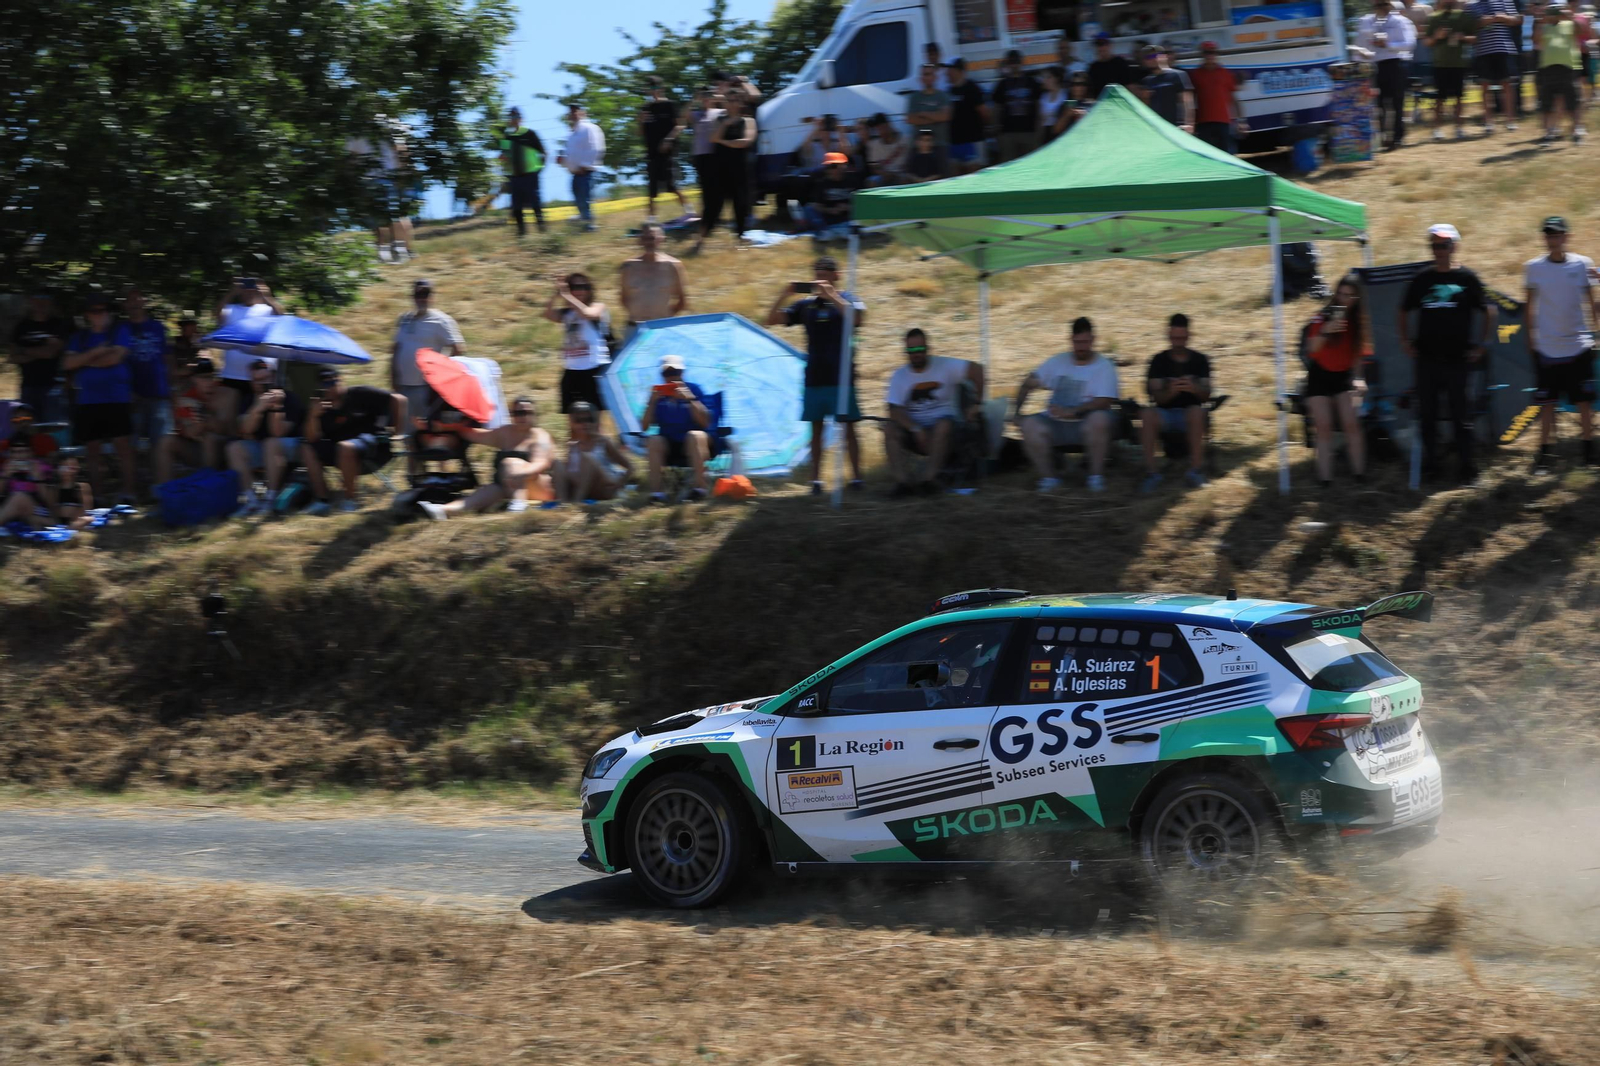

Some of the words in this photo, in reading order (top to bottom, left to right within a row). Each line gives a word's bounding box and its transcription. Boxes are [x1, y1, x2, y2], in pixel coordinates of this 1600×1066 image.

[1055, 660, 1082, 674] J.A.
[1086, 658, 1135, 672] Suárez
[1145, 655, 1160, 690] 1
[1224, 664, 1254, 672] TURINI
[789, 665, 836, 697] SKODA
[1053, 679, 1068, 691] A.
[1071, 677, 1127, 694] Iglesias
[797, 697, 814, 708] RACC
[990, 703, 1102, 764] GSS
[789, 740, 801, 766] 1
[819, 742, 842, 756] La
[996, 765, 1046, 784] Subsea
[1049, 753, 1106, 773] Services
[800, 774, 832, 785] Recalvi
[803, 794, 835, 803] recoletos
[836, 793, 854, 801] salud
